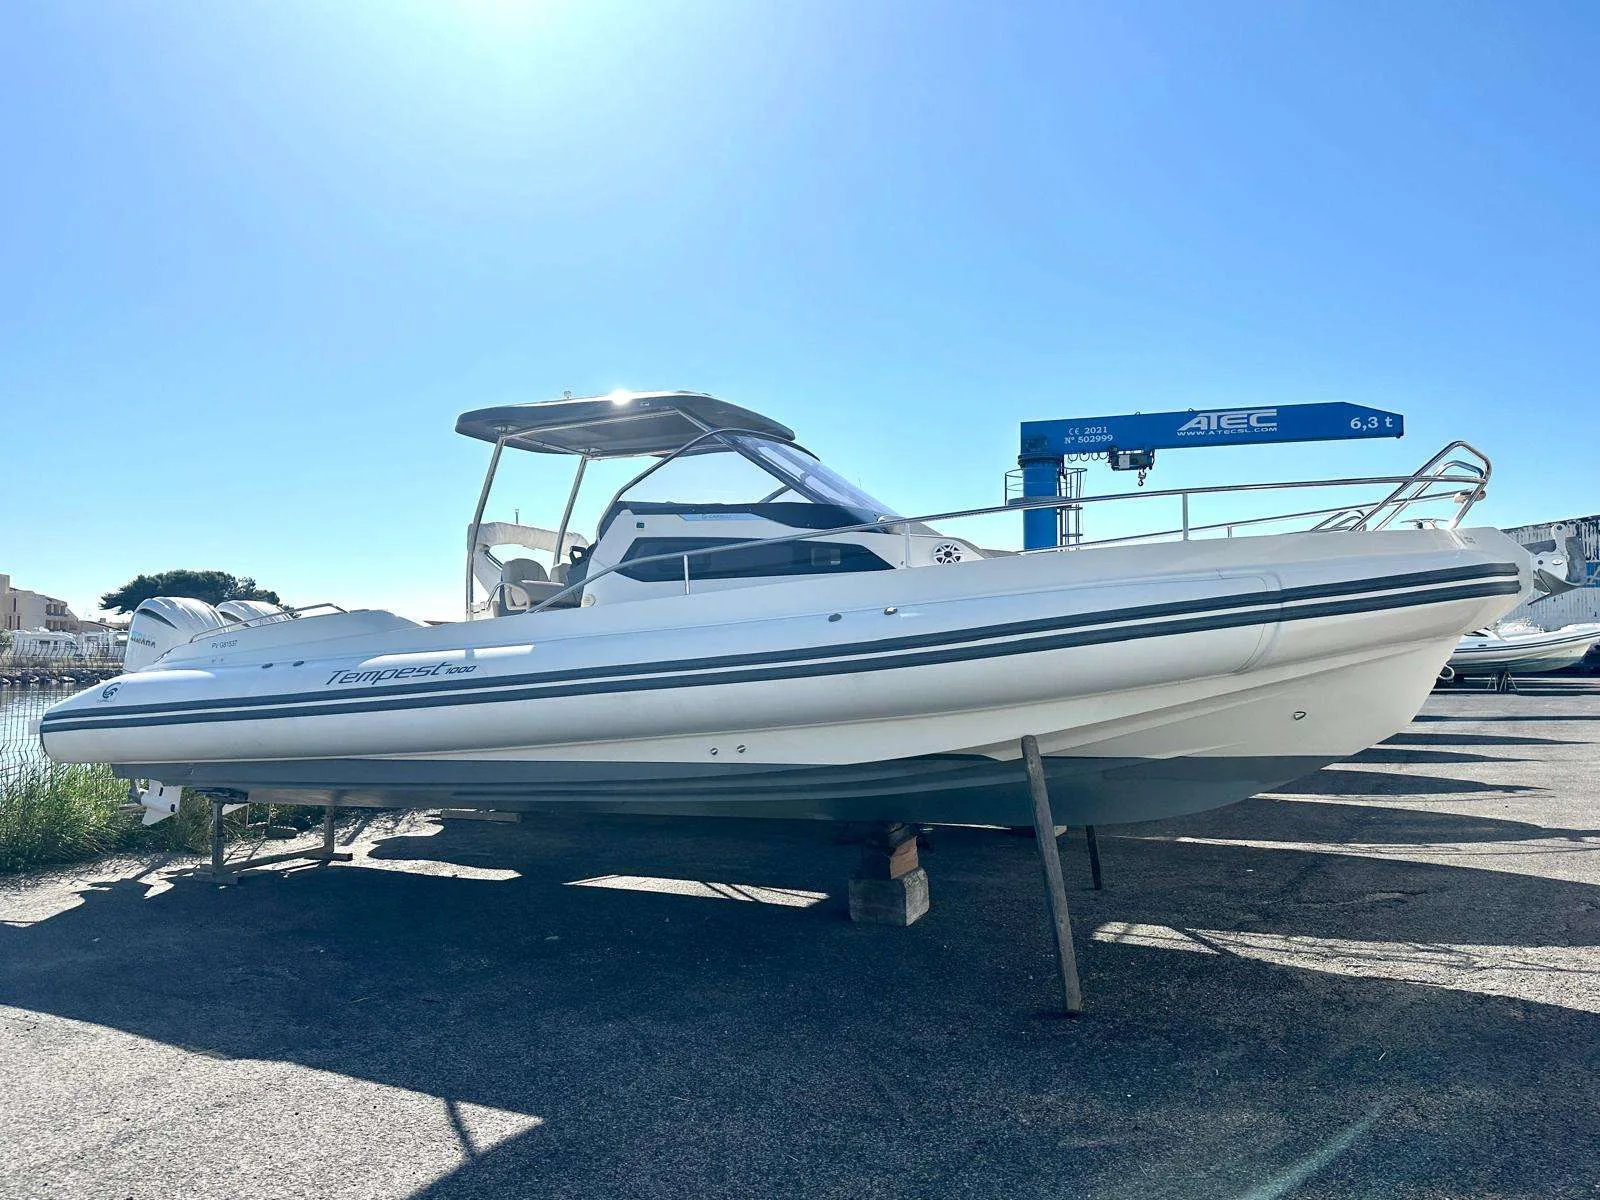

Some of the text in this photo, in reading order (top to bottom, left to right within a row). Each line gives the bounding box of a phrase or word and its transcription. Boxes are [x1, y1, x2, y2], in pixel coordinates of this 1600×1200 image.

[1177, 408, 1278, 431] ATEC
[1350, 416, 1393, 431] 6,3 t
[1084, 426, 1108, 435] 2021
[1176, 426, 1278, 437] WWW.ATECSL.COM
[1077, 434, 1114, 443] 502999
[326, 661, 478, 685] Tempest 1000
